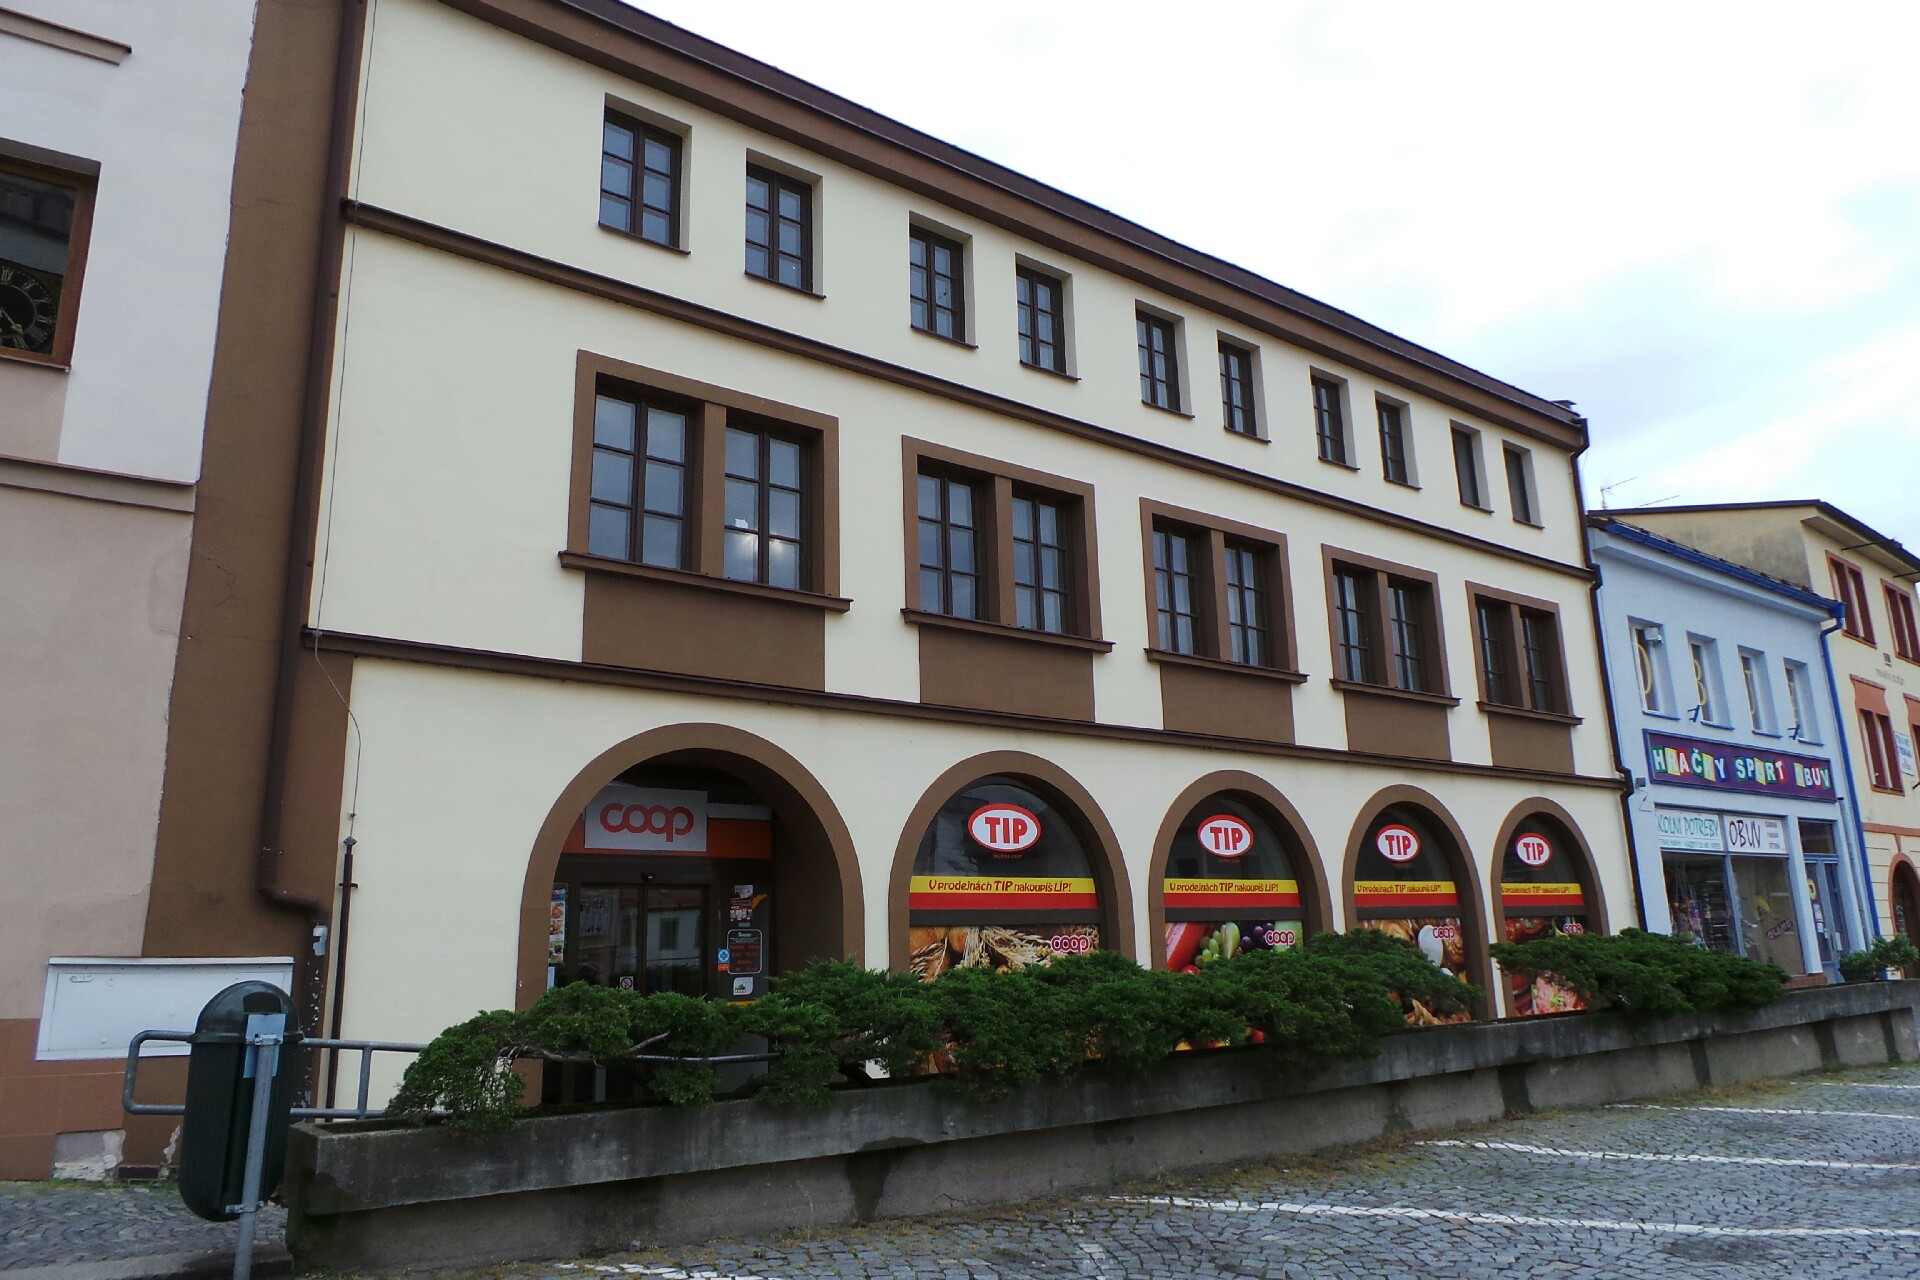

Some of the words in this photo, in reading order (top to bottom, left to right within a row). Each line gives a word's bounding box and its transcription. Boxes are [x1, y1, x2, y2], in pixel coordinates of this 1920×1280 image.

[1653, 748, 1725, 779] HRAČKY
[1735, 759, 1783, 782] SPORT
[1795, 763, 1831, 788] OBUV
[600, 803, 694, 842] coop
[985, 817, 1028, 844] TIP
[1210, 827, 1243, 850] TIP
[1729, 820, 1760, 848] OBUV
[1385, 835, 1411, 855] TIP
[1523, 842, 1544, 860] TIP
[938, 880, 992, 891] prodejnách
[994, 880, 1013, 891] TIP
[1014, 882, 1053, 892] nakoupíš
[1054, 880, 1072, 892] LÍP!
[1177, 883, 1218, 892] prodejnách
[1219, 882, 1233, 892] TIP
[1394, 884, 1407, 892] TIP
